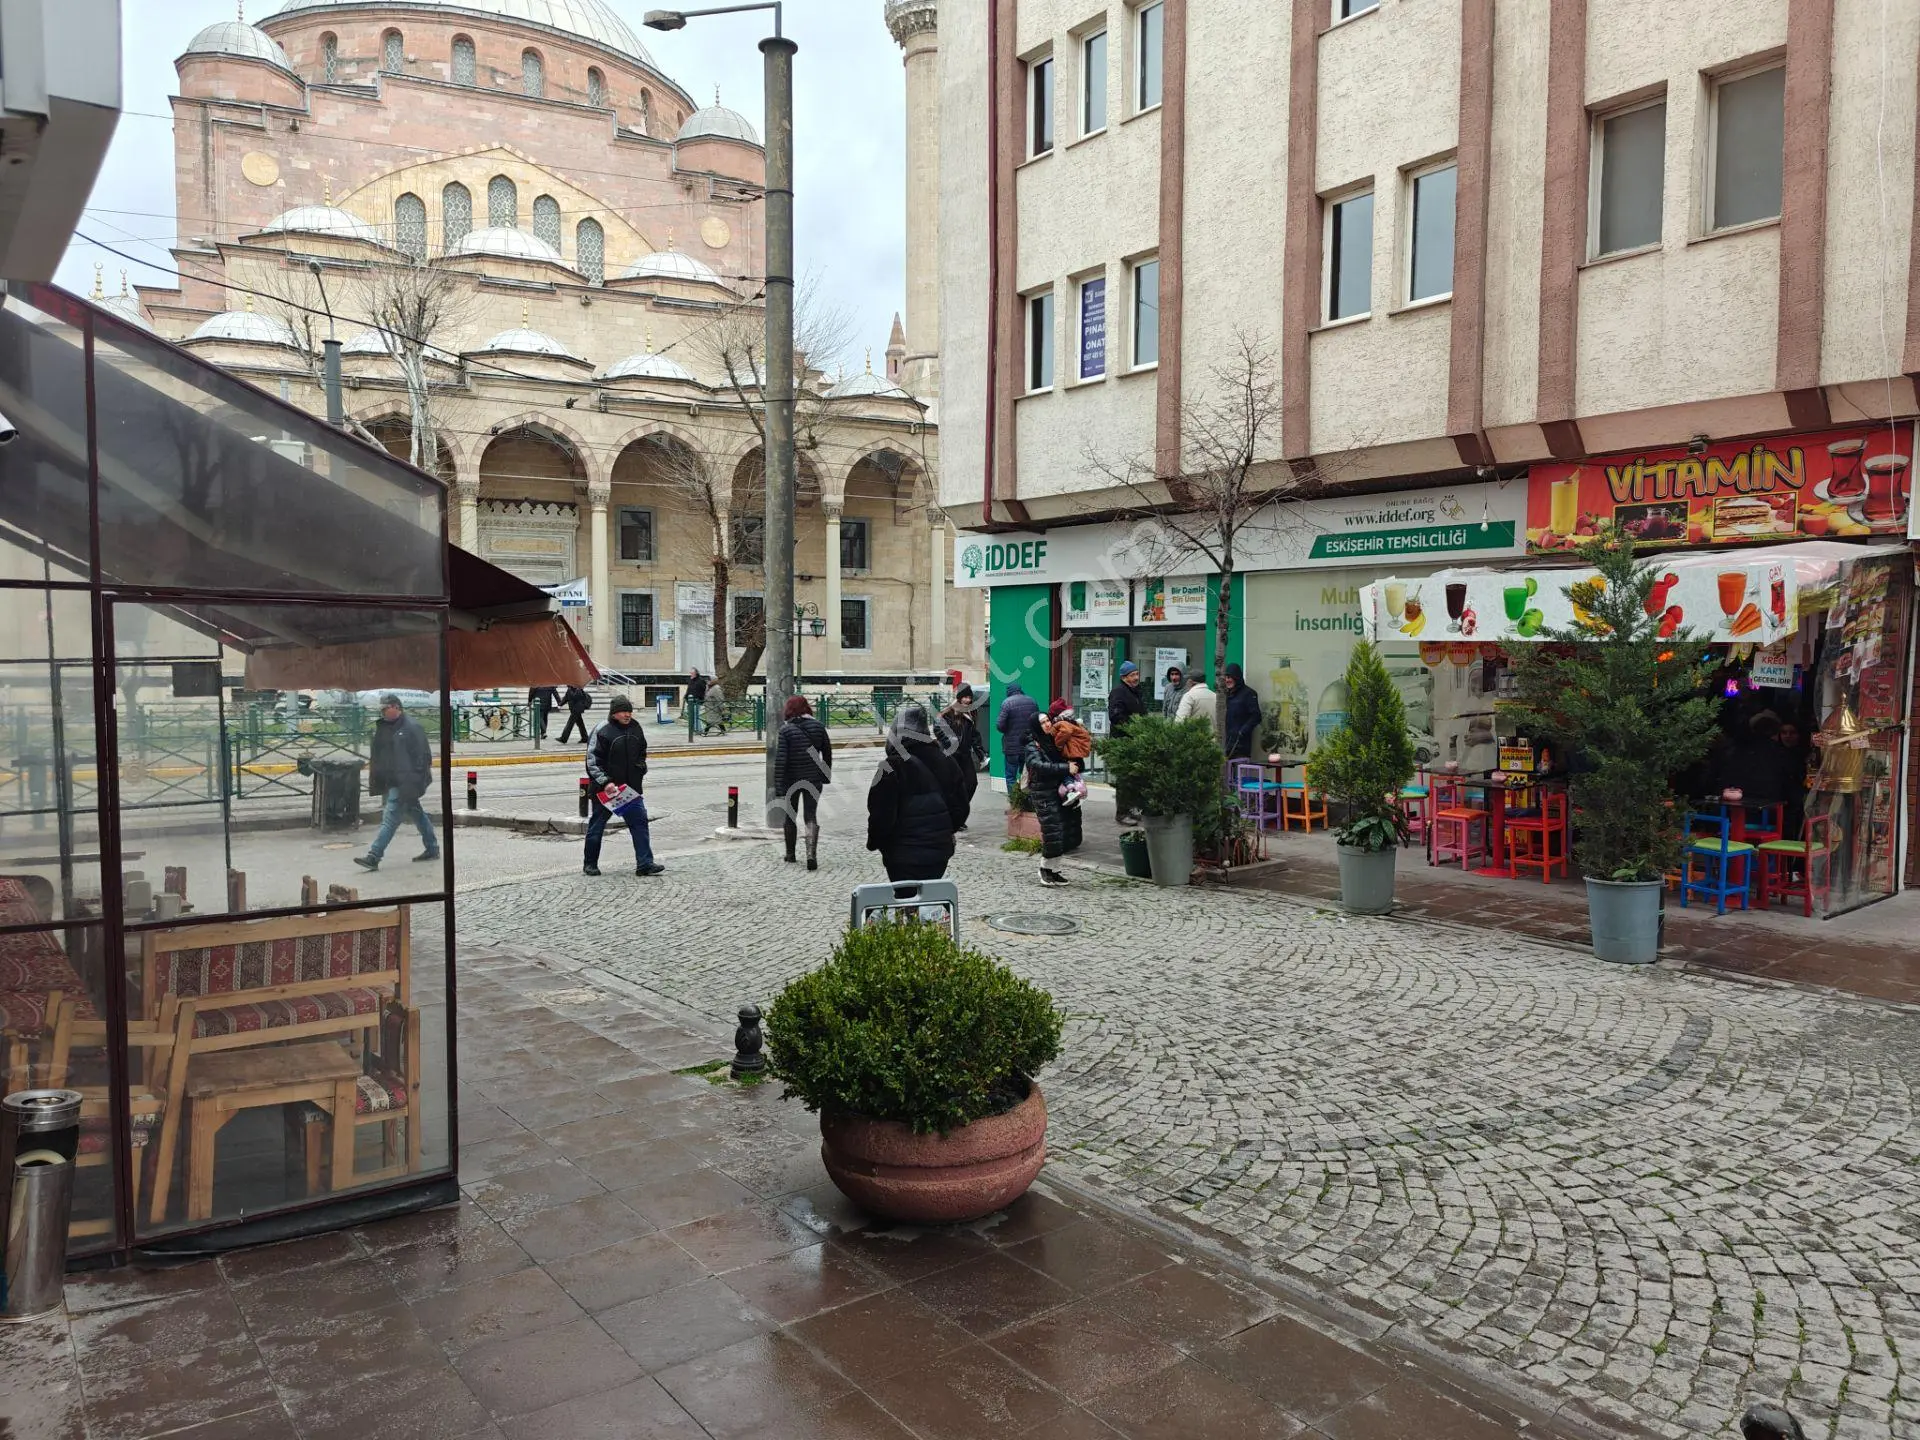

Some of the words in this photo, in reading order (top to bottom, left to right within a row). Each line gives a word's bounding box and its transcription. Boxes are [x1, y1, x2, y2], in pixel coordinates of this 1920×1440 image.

[1604, 443, 1806, 502] VİTAMİN
[1344, 507, 1435, 526] www.iddef.org
[1325, 537, 1384, 554] ESKİŞEHİR
[1386, 529, 1467, 549] TEMSİLCİLİĞİ
